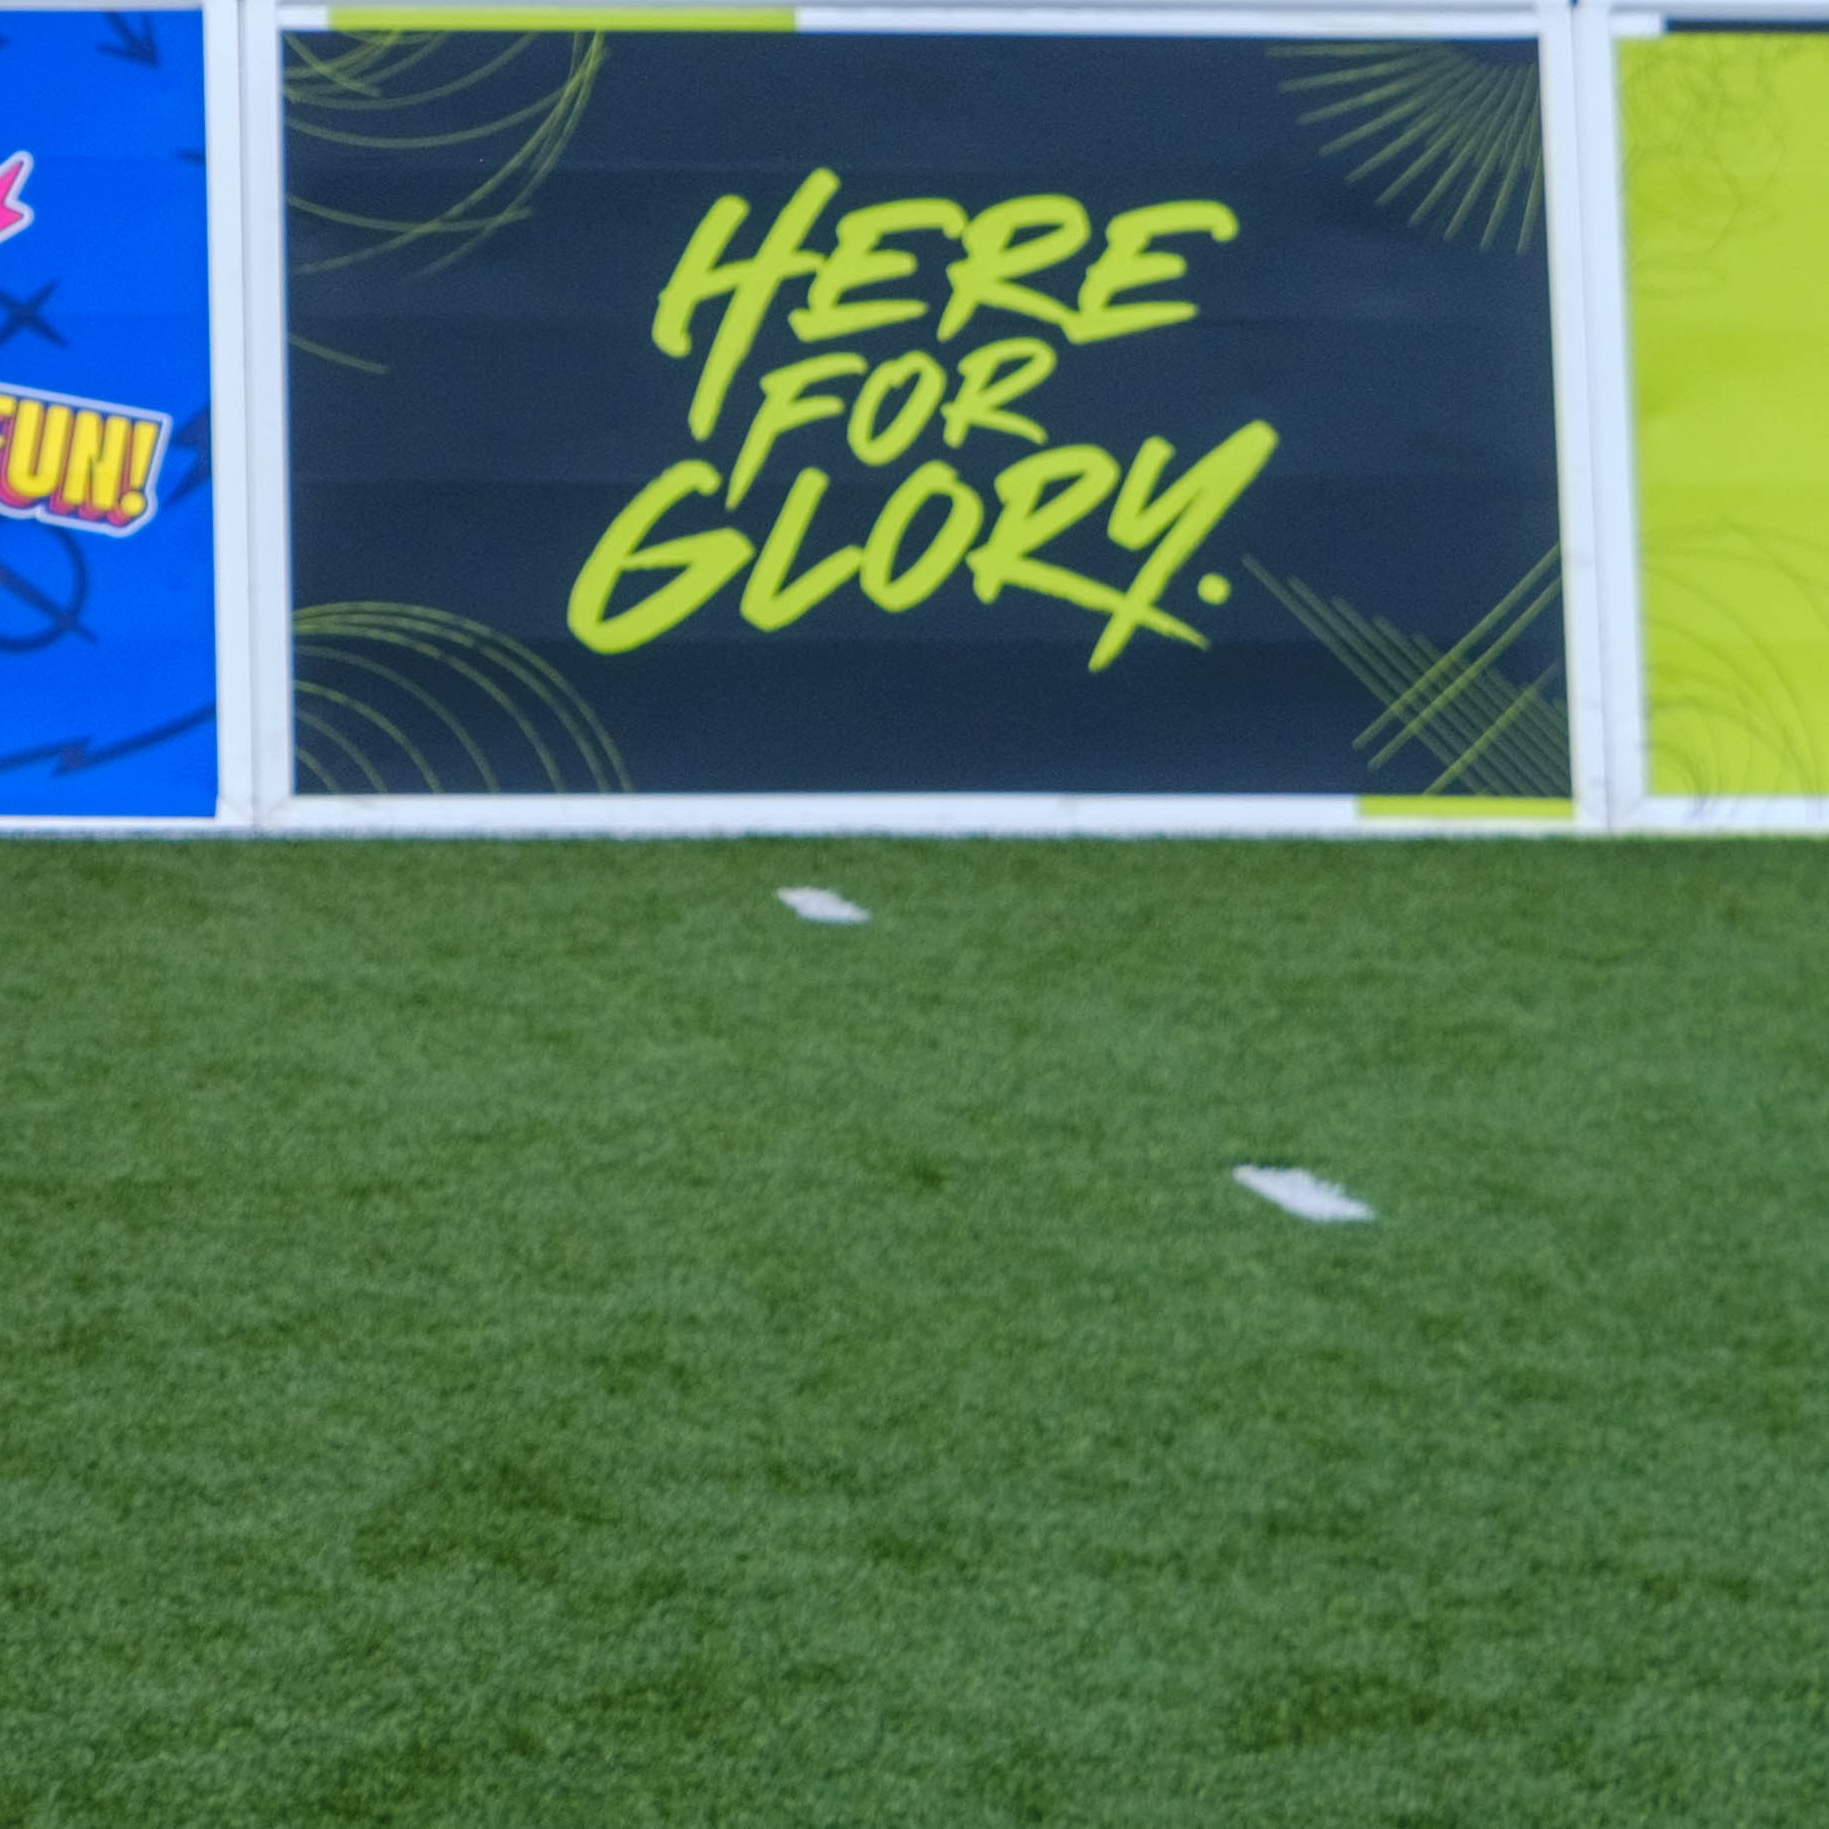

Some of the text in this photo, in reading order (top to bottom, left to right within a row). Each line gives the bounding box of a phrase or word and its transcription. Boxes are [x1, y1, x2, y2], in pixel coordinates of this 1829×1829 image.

[650, 166, 1238, 440] HERE
[725, 336, 1057, 506] FOR
[566, 419, 1279, 671] GLORY.
